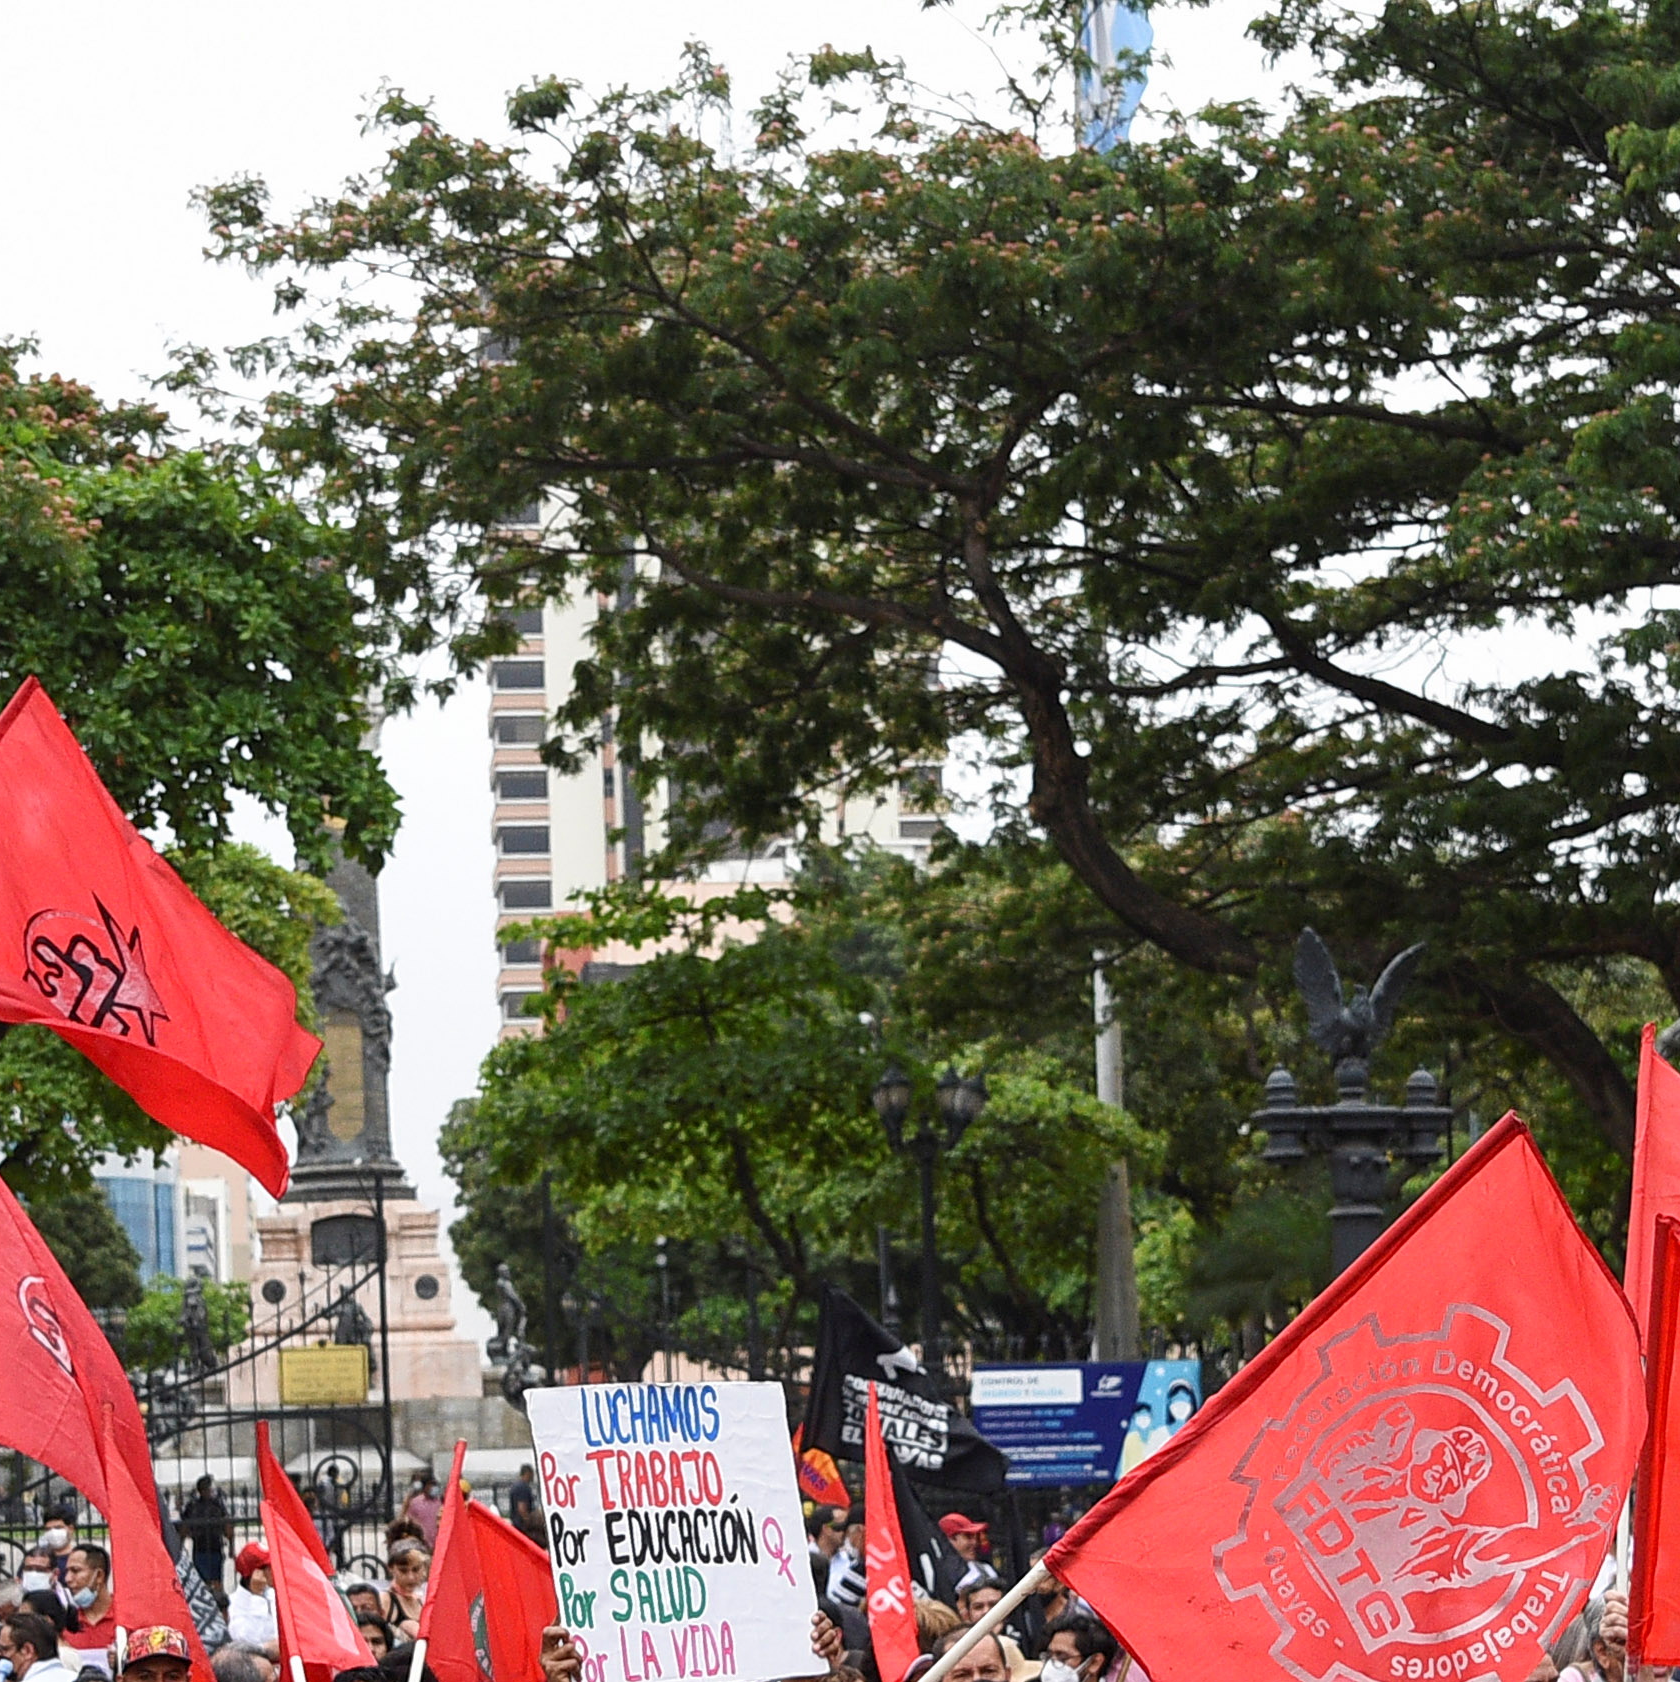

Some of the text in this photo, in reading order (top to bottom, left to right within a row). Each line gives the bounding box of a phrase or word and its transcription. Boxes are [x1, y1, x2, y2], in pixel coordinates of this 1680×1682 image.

[581, 1385, 720, 1447] LUCHAMOS
[881, 1417, 948, 1453] ALES
[540, 1449, 723, 1510] Por TRABAJO
[550, 1493, 759, 1568] Por EDUCACIÓN
[1271, 1349, 1571, 1680] Federación Democrática Trabajadores
[1264, 1545, 1331, 1640] Guayas
[1283, 1484, 1402, 1641] FDTG
[559, 1565, 707, 1628] Por SALUD
[620, 1625, 663, 1682] LA
[671, 1621, 737, 1679] VIDA
